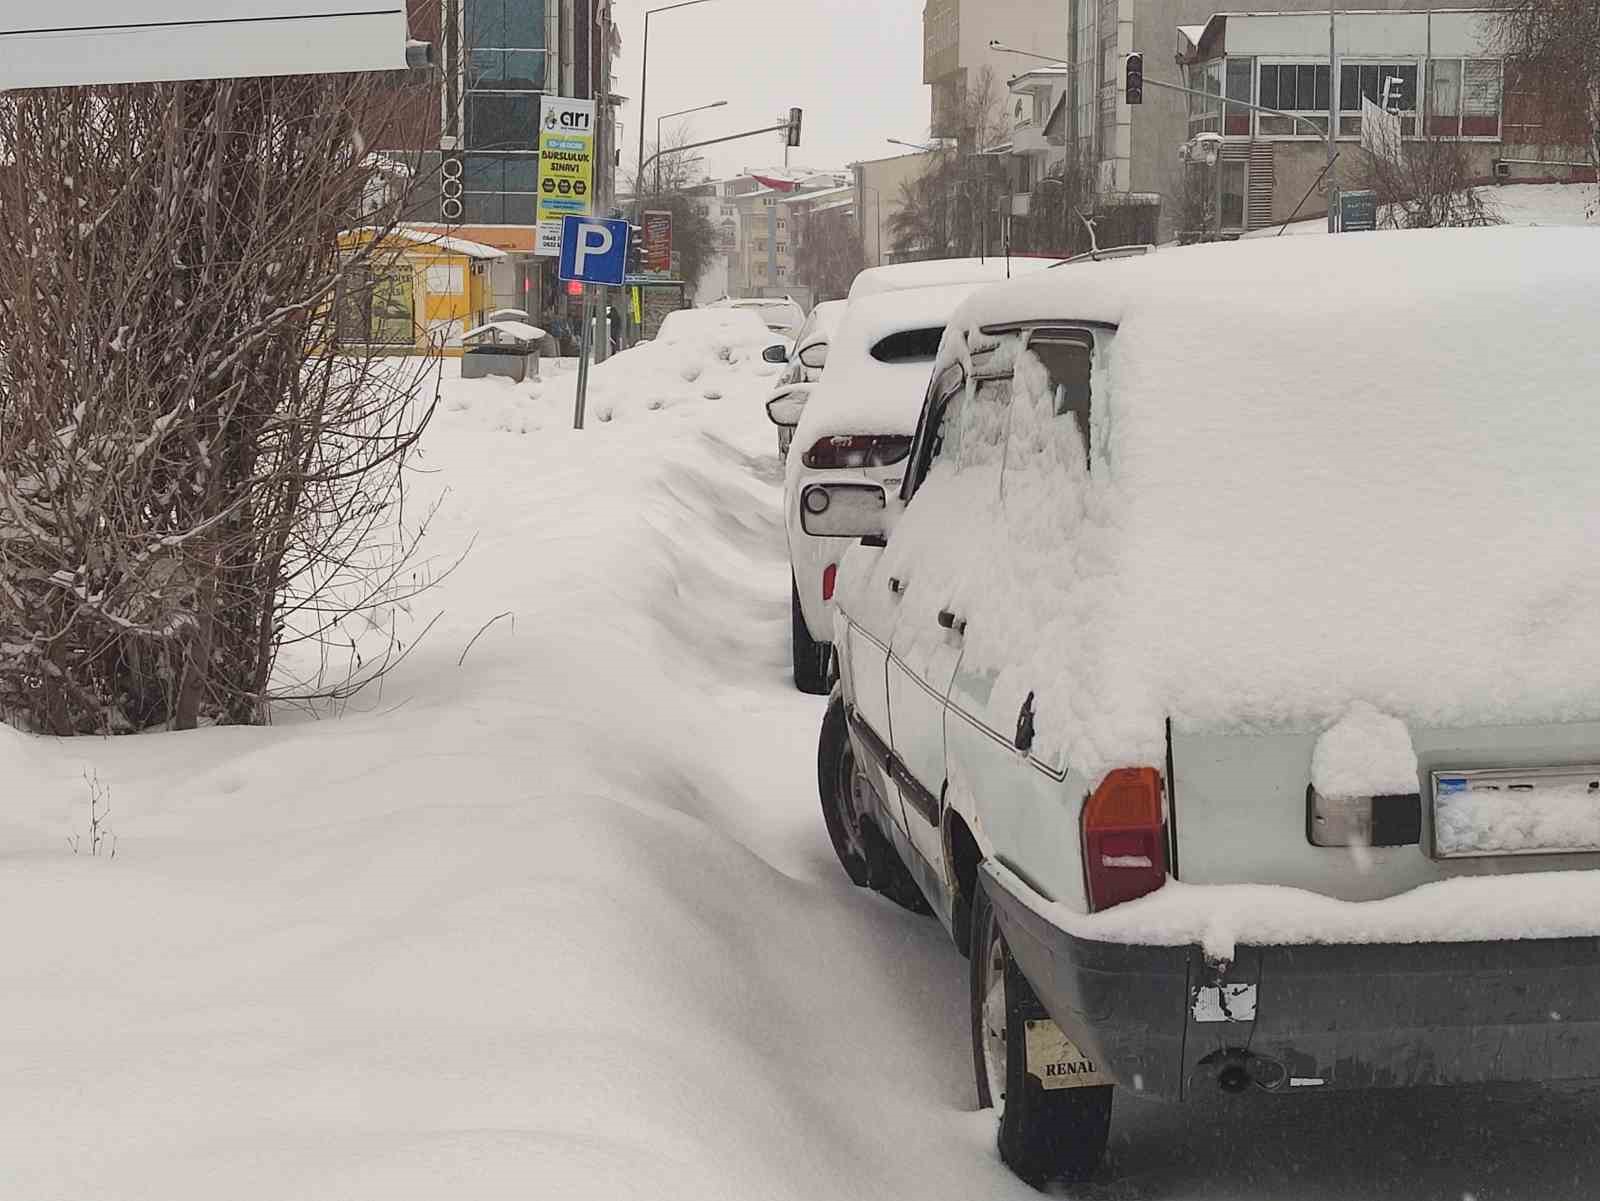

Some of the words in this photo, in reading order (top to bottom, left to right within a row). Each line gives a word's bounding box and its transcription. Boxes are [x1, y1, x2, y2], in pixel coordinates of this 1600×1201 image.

[542, 150, 590, 162] BURSLULUK
[550, 162, 580, 173] SINAVI
[574, 223, 613, 276] P
